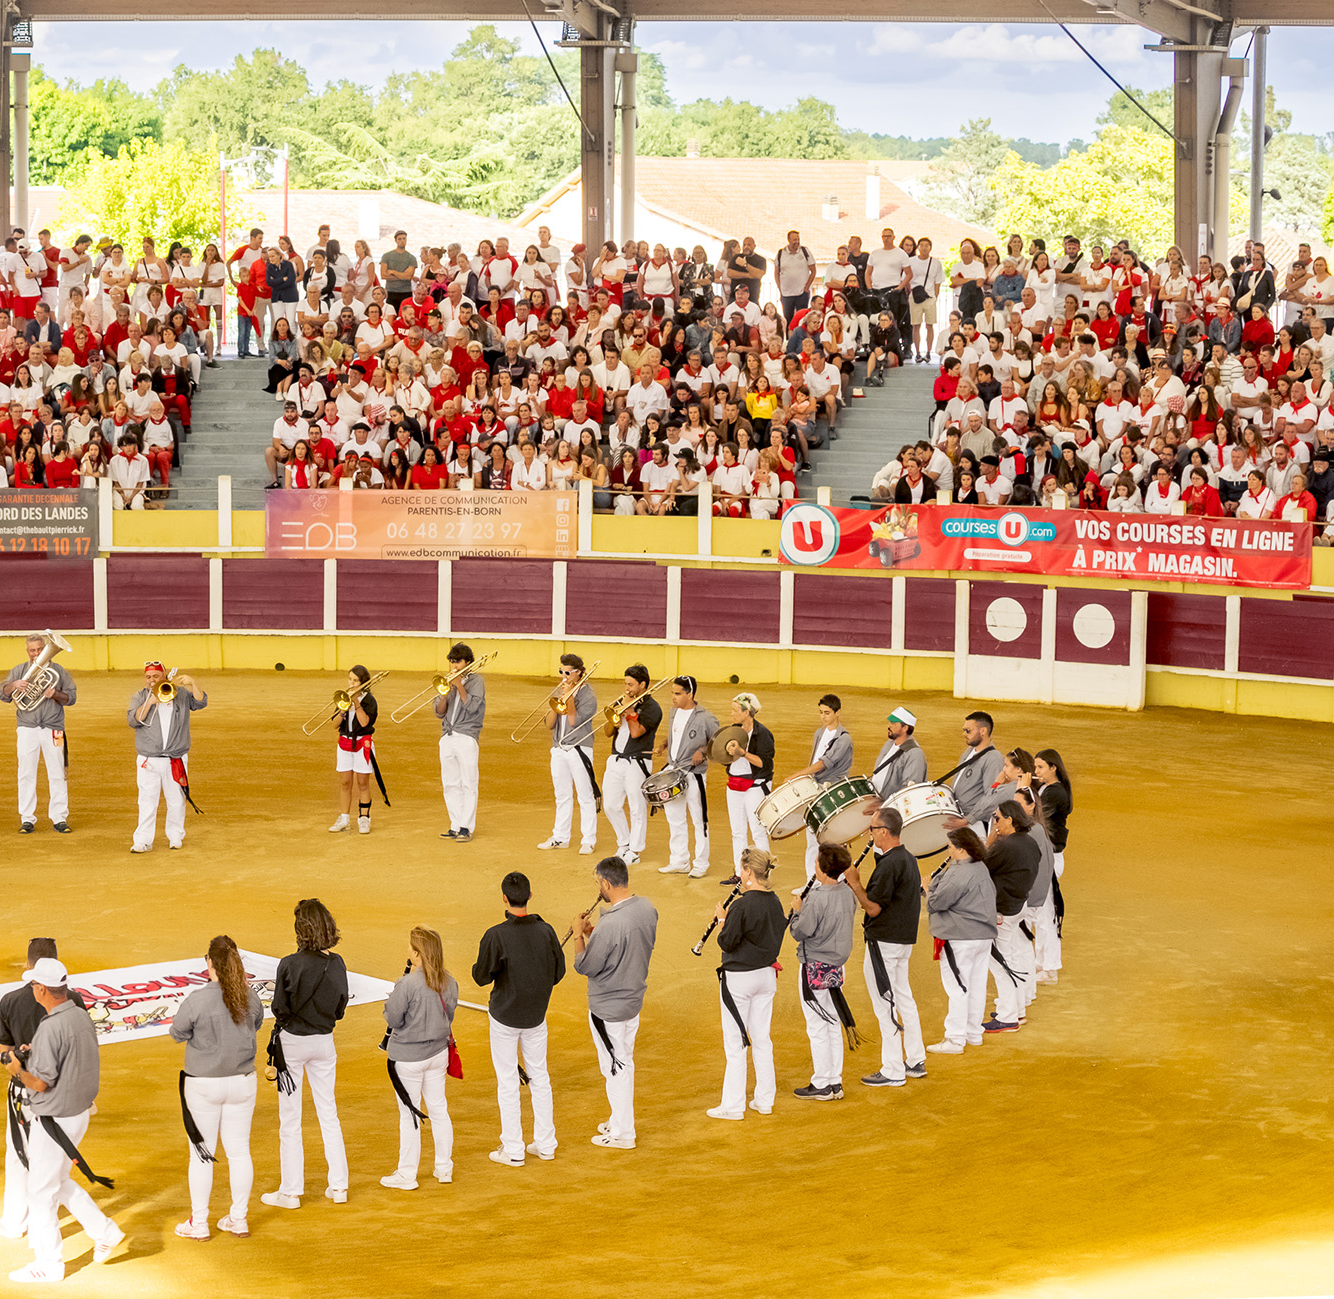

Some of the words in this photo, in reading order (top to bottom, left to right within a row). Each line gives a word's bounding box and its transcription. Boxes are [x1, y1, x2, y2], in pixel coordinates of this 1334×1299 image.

[36, 494, 79, 503] DECENNALE
[381, 496, 422, 505] AGENCE
[424, 496, 438, 505] DE
[439, 496, 528, 505] COMMUNICATION
[21, 507, 42, 520] DES
[45, 507, 88, 520] LANDES
[407, 507, 502, 516] PARENTIS-EN-BORN
[282, 521, 357, 550] EDB
[387, 522, 409, 539] 06
[414, 522, 437, 539] 48
[445, 522, 466, 539] 27
[473, 522, 494, 539] 23
[501, 522, 522, 539] 97
[792, 520, 824, 552] U
[945, 520, 996, 535] courses
[1005, 522, 1021, 538] U
[1030, 527, 1053, 538] .com
[1075, 519, 1111, 540] VOS
[1116, 521, 1206, 546] COURSES
[1211, 527, 1237, 549] EN
[1242, 530, 1294, 551] LIGNE
[10, 537, 26, 552] 12
[31, 537, 48, 552] 18
[53, 537, 70, 555] 10
[75, 537, 91, 555] 17
[386, 547, 522, 557] www.edbcommunication.fr
[1072, 544, 1086, 568] À
[1148, 553, 1237, 578] MAGASIN.
